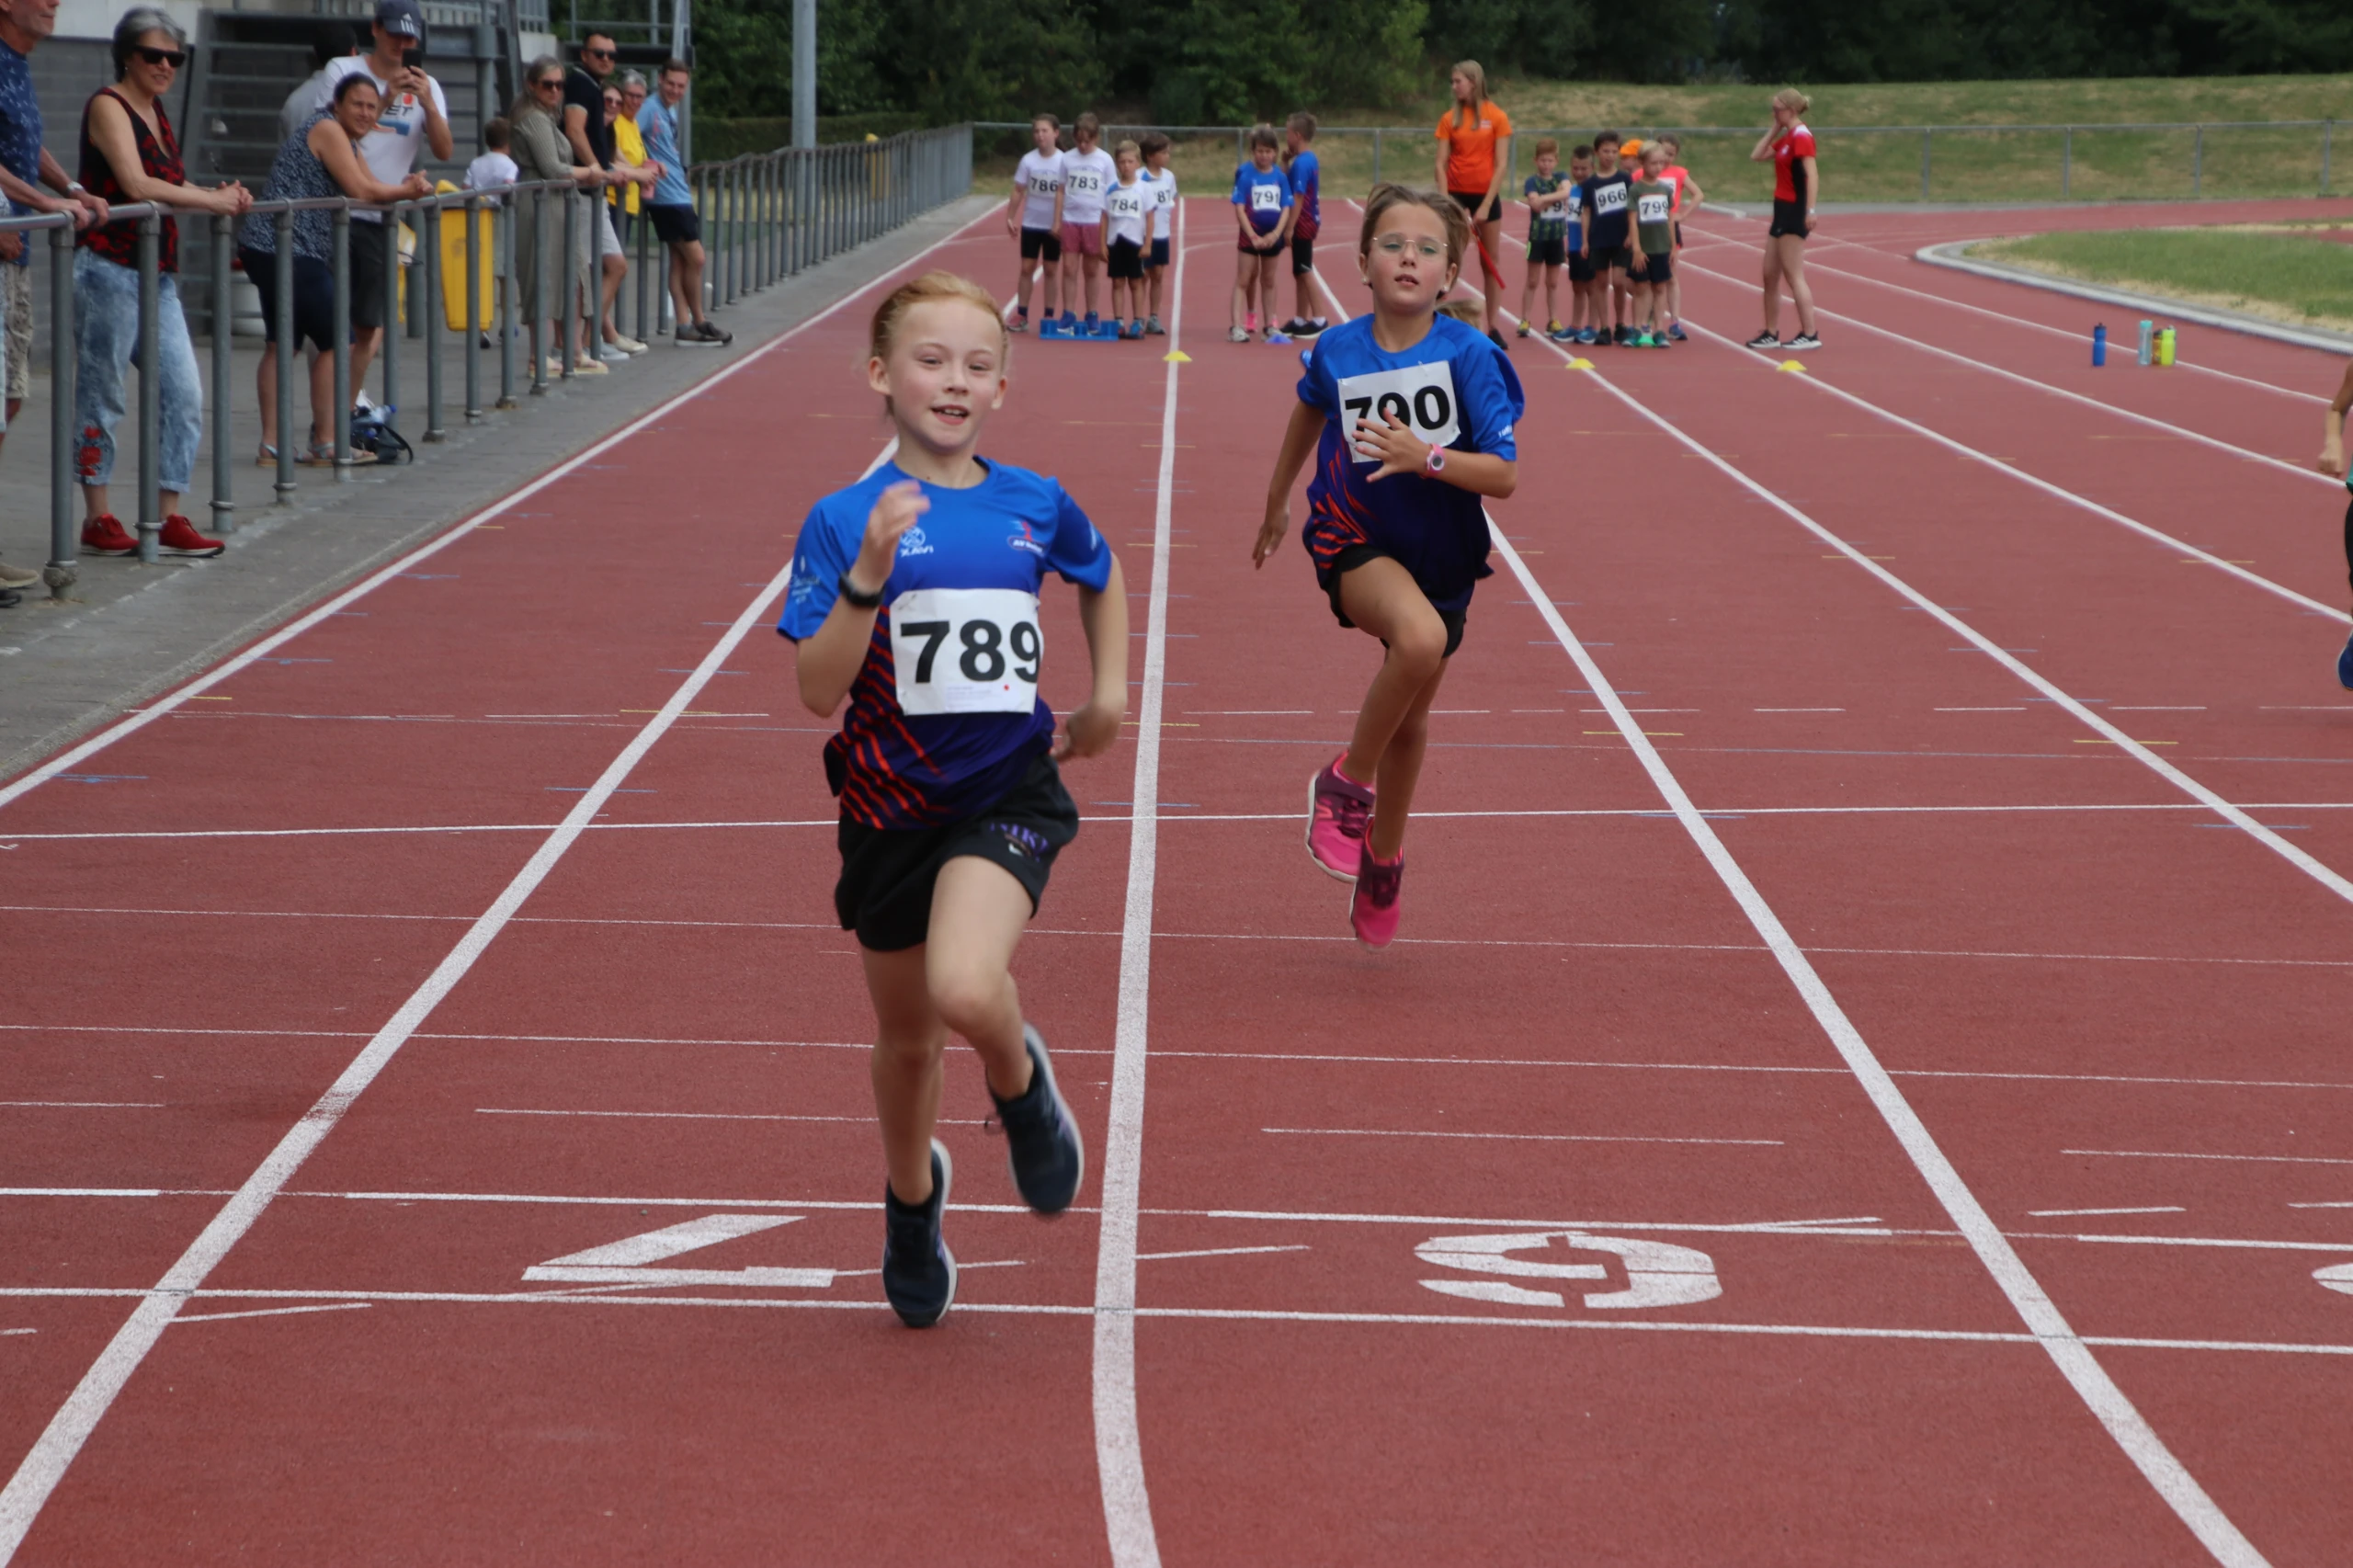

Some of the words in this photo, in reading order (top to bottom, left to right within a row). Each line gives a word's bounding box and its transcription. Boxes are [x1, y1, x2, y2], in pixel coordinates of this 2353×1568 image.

[1030, 177, 1058, 192] 786
[1070, 175, 1098, 190] 783
[1154, 189, 1171, 204] 87
[1254, 191, 1279, 205] 791
[1598, 189, 1627, 207] 966
[1111, 199, 1139, 212] 784
[1642, 201, 1668, 215] 799
[1345, 385, 1450, 442] 790
[901, 619, 1041, 684] 789
